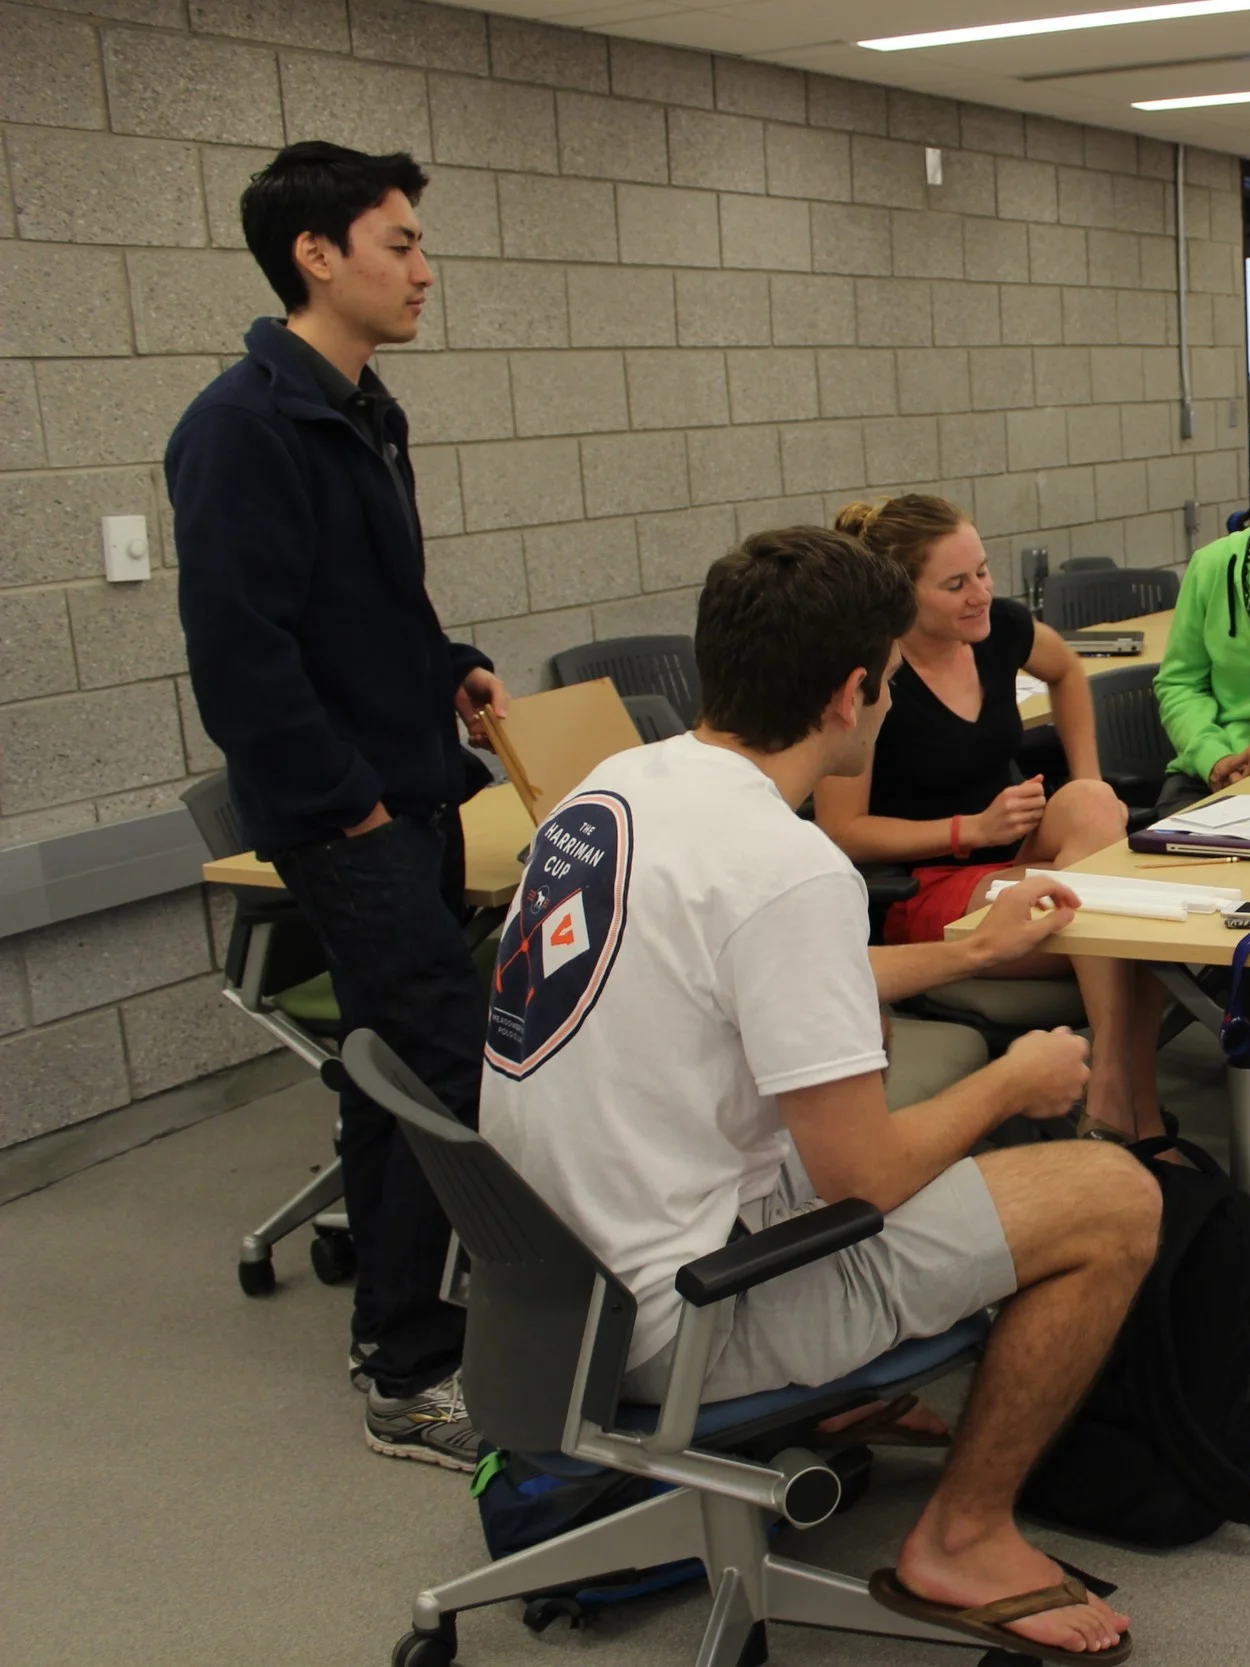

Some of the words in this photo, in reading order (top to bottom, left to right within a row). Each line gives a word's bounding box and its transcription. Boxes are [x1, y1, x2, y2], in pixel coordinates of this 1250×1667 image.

[579, 822, 596, 836] THE
[544, 822, 605, 867] HARRIMAN
[544, 855, 572, 880] CUP
